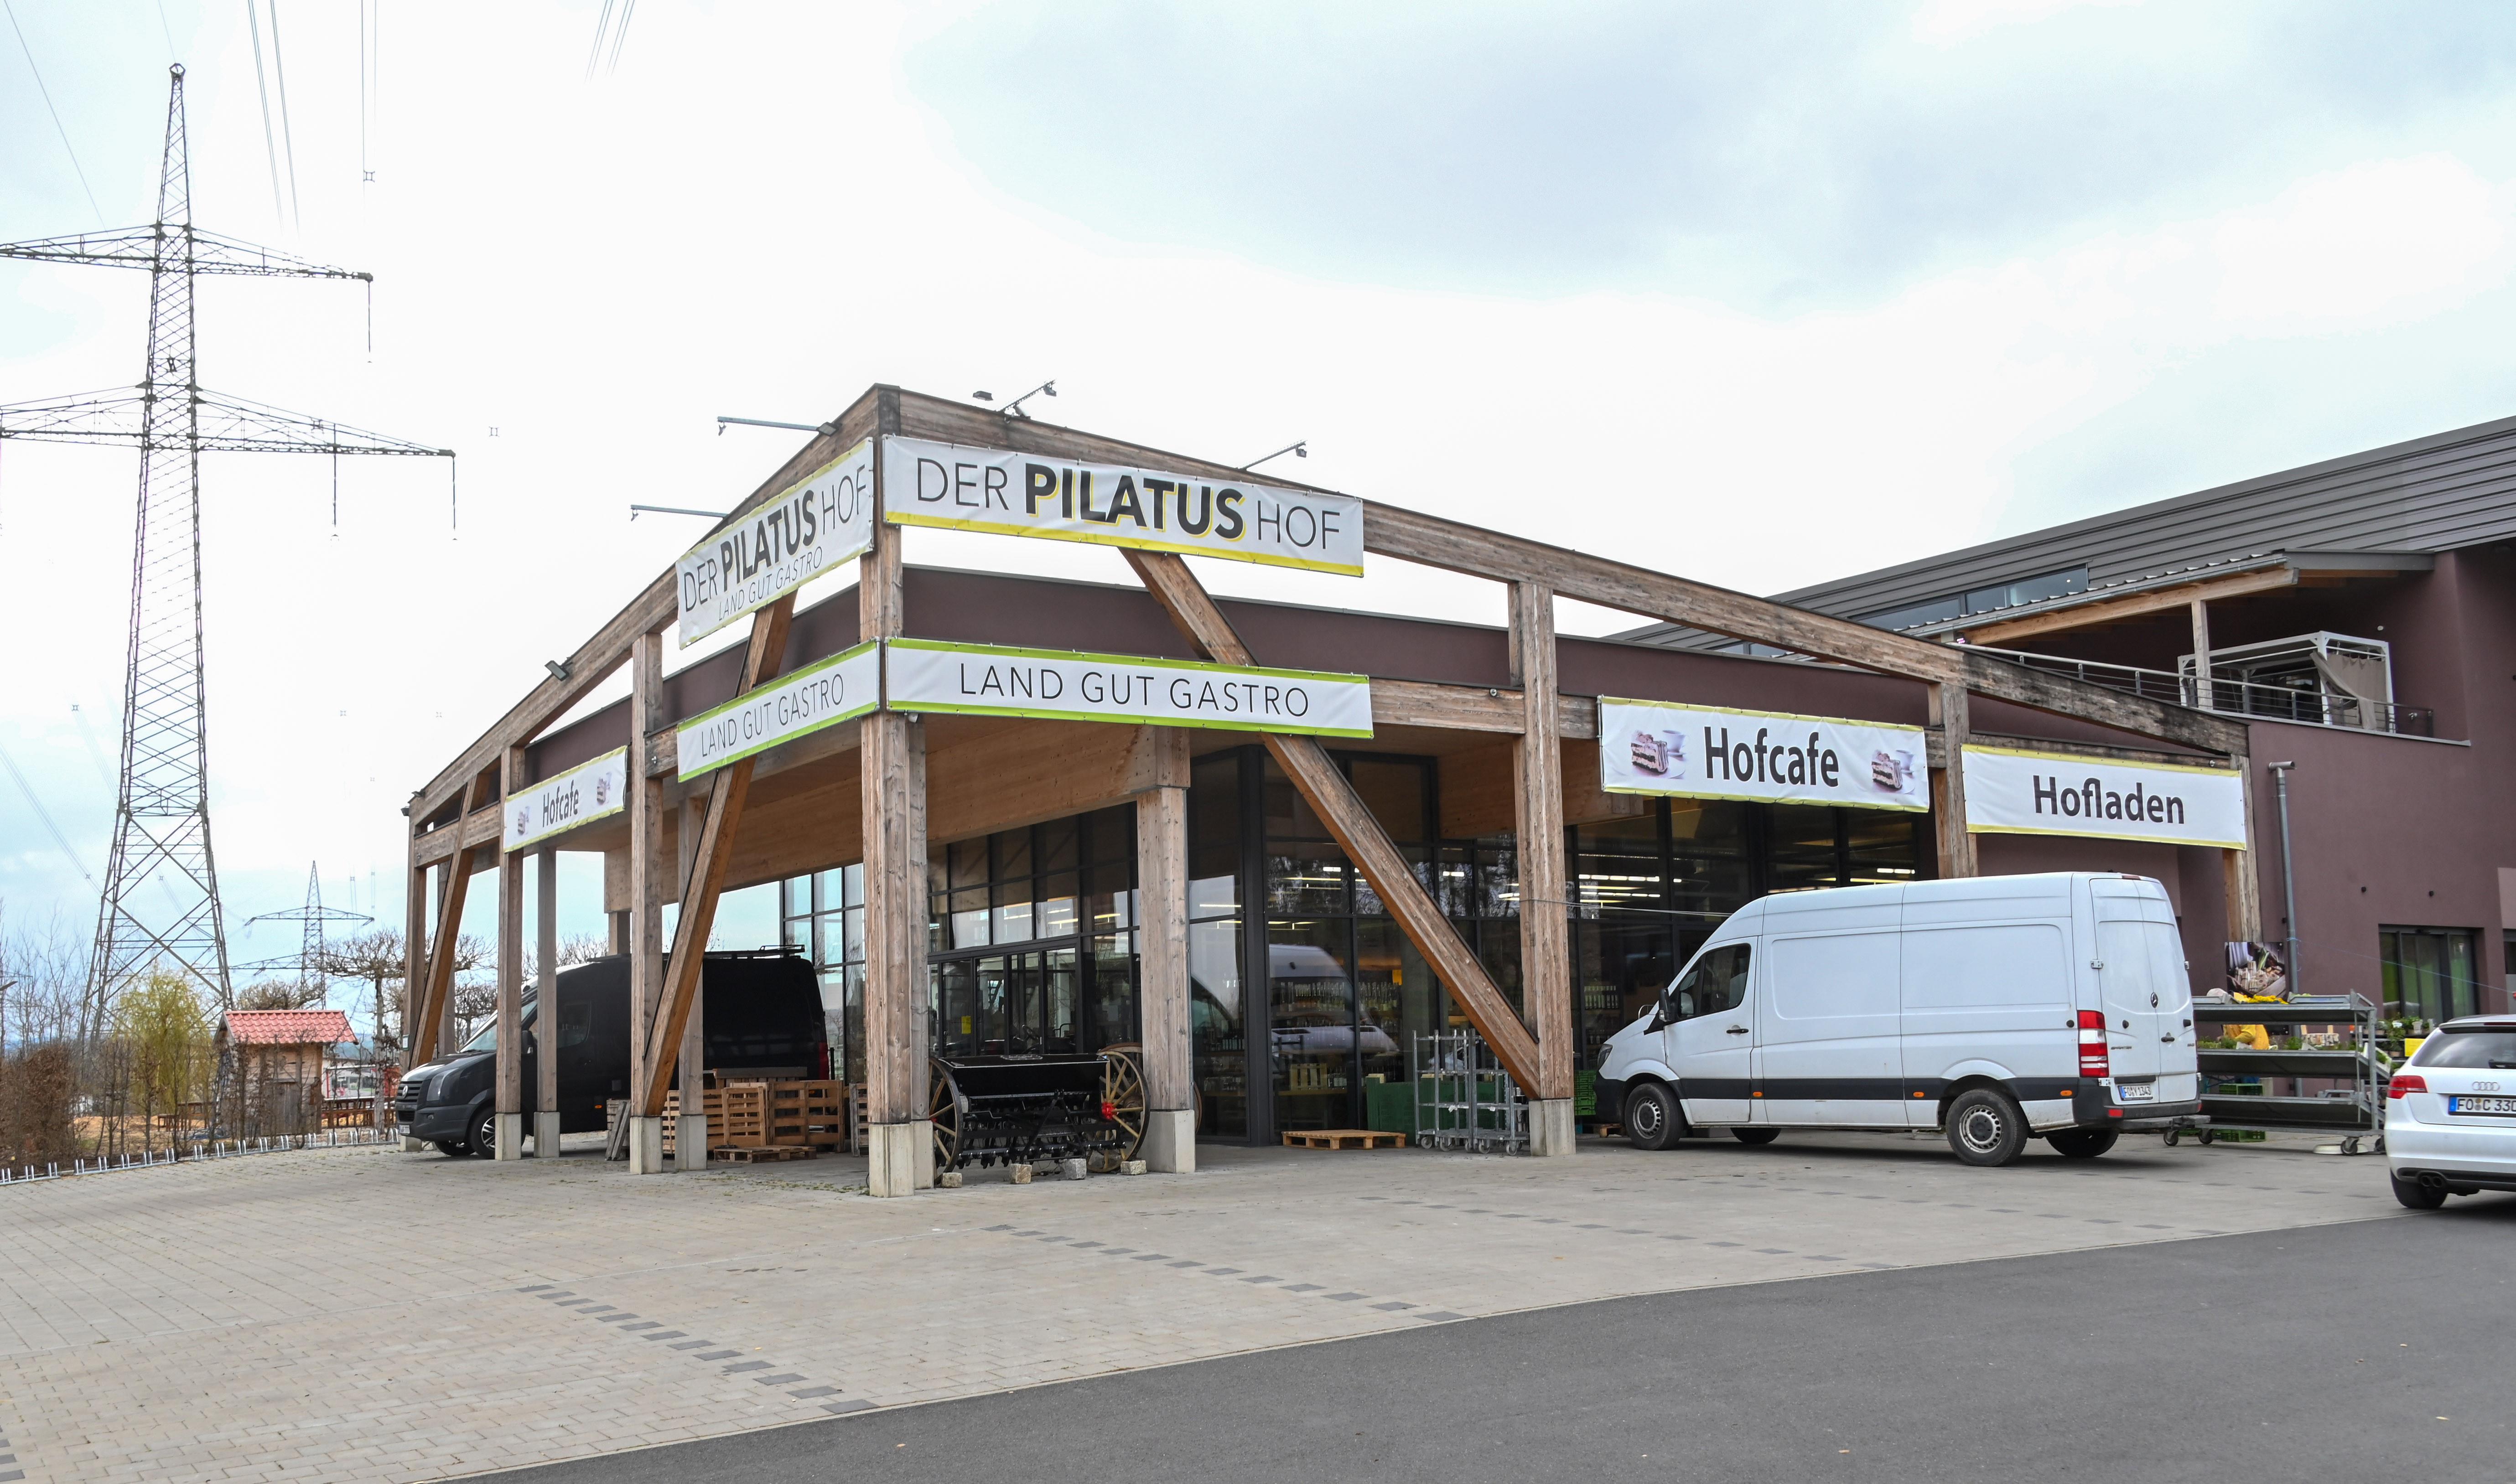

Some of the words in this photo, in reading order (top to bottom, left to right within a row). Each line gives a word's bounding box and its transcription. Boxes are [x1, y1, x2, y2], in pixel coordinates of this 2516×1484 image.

[917, 457, 1009, 511] DER
[1025, 463, 1246, 543] PILATUS
[1257, 500, 1340, 549] HOF
[684, 558, 718, 612] DER
[720, 490, 817, 592] PILATUS
[821, 464, 866, 535] HOF
[718, 589, 745, 621] LAND
[748, 573, 773, 604] GUT
[775, 546, 823, 590] GASTRO
[701, 718, 737, 757] LAND
[743, 702, 772, 740] GUT
[778, 673, 844, 726] GASTRO
[960, 662, 1063, 700] LAND
[1081, 672, 1155, 706] GUT
[1169, 678, 1309, 717] GASTRO
[1704, 726, 1839, 787] Hofcafe
[542, 779, 579, 827] Hofcafe
[2033, 775, 2185, 824] Hofladen
[2457, 1098, 2474, 1111] FO
[2483, 1099, 2490, 1111] C
